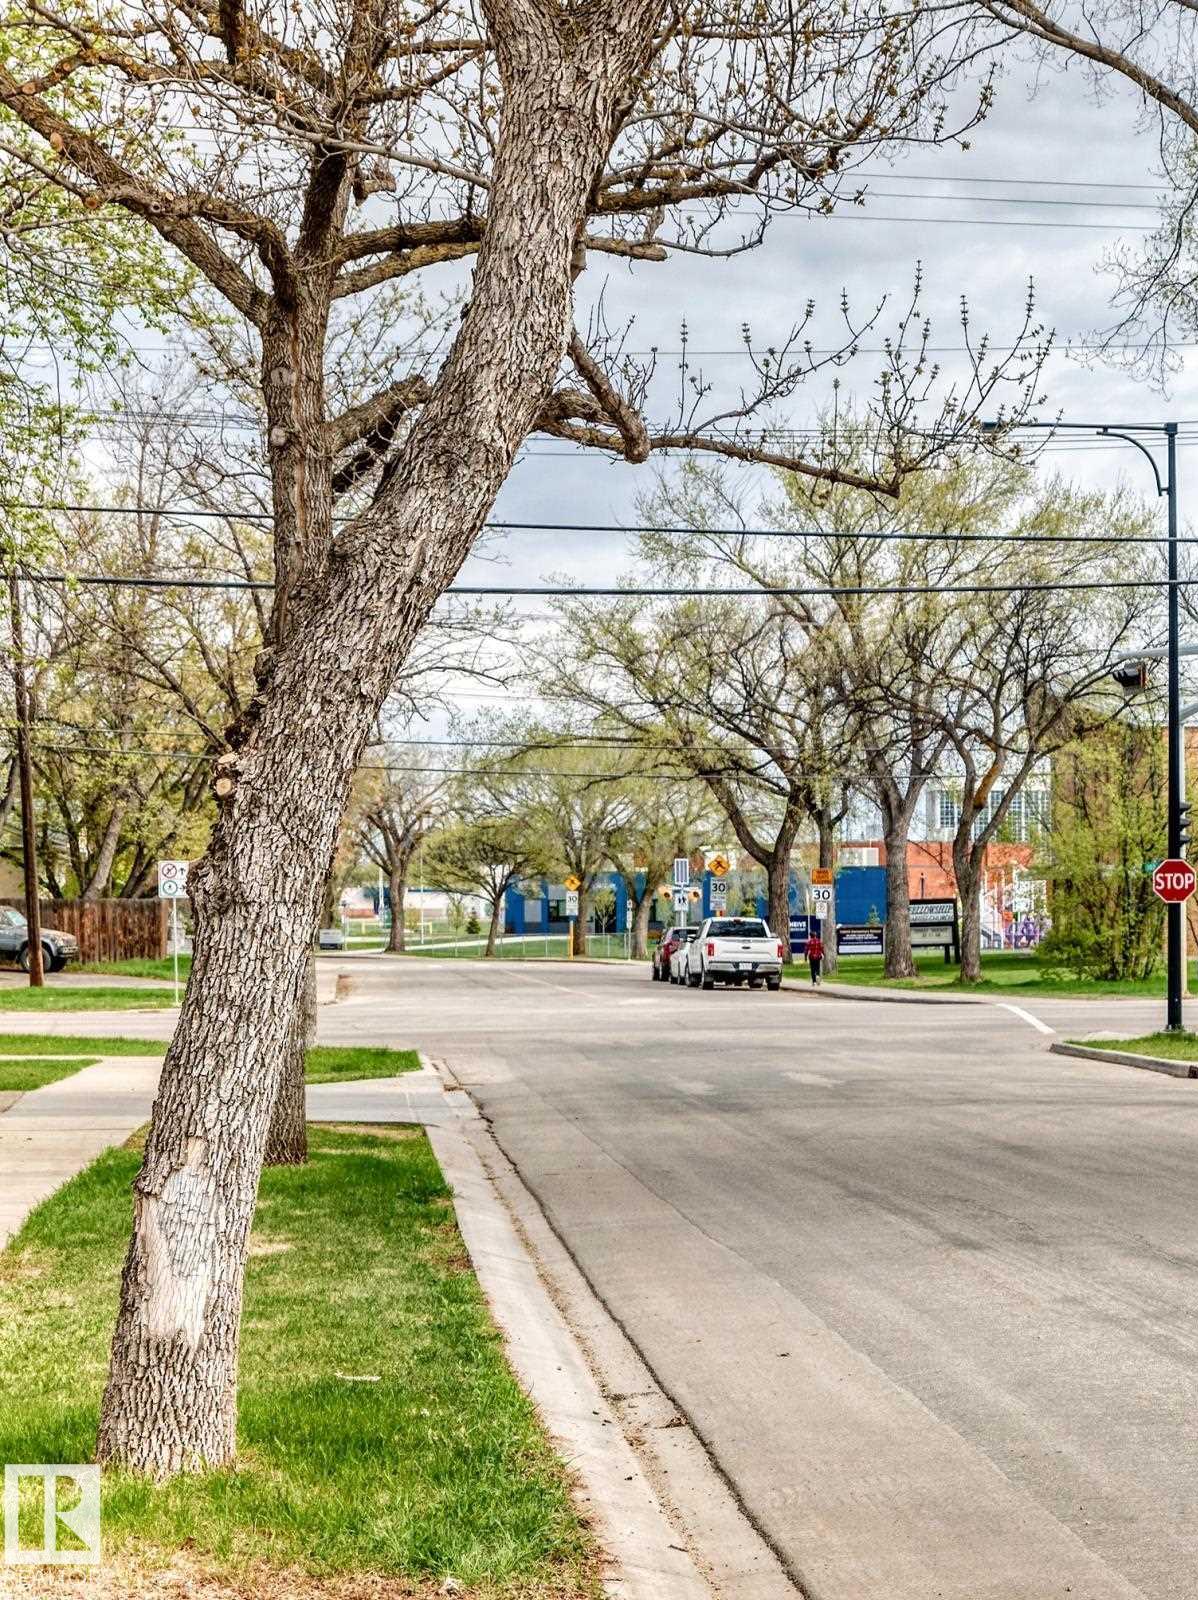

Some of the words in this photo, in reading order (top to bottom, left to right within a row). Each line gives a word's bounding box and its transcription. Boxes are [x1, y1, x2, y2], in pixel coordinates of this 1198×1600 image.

[1155, 873, 1194, 890] STOP
[712, 883, 726, 892] 30
[813, 889, 831, 900] 30
